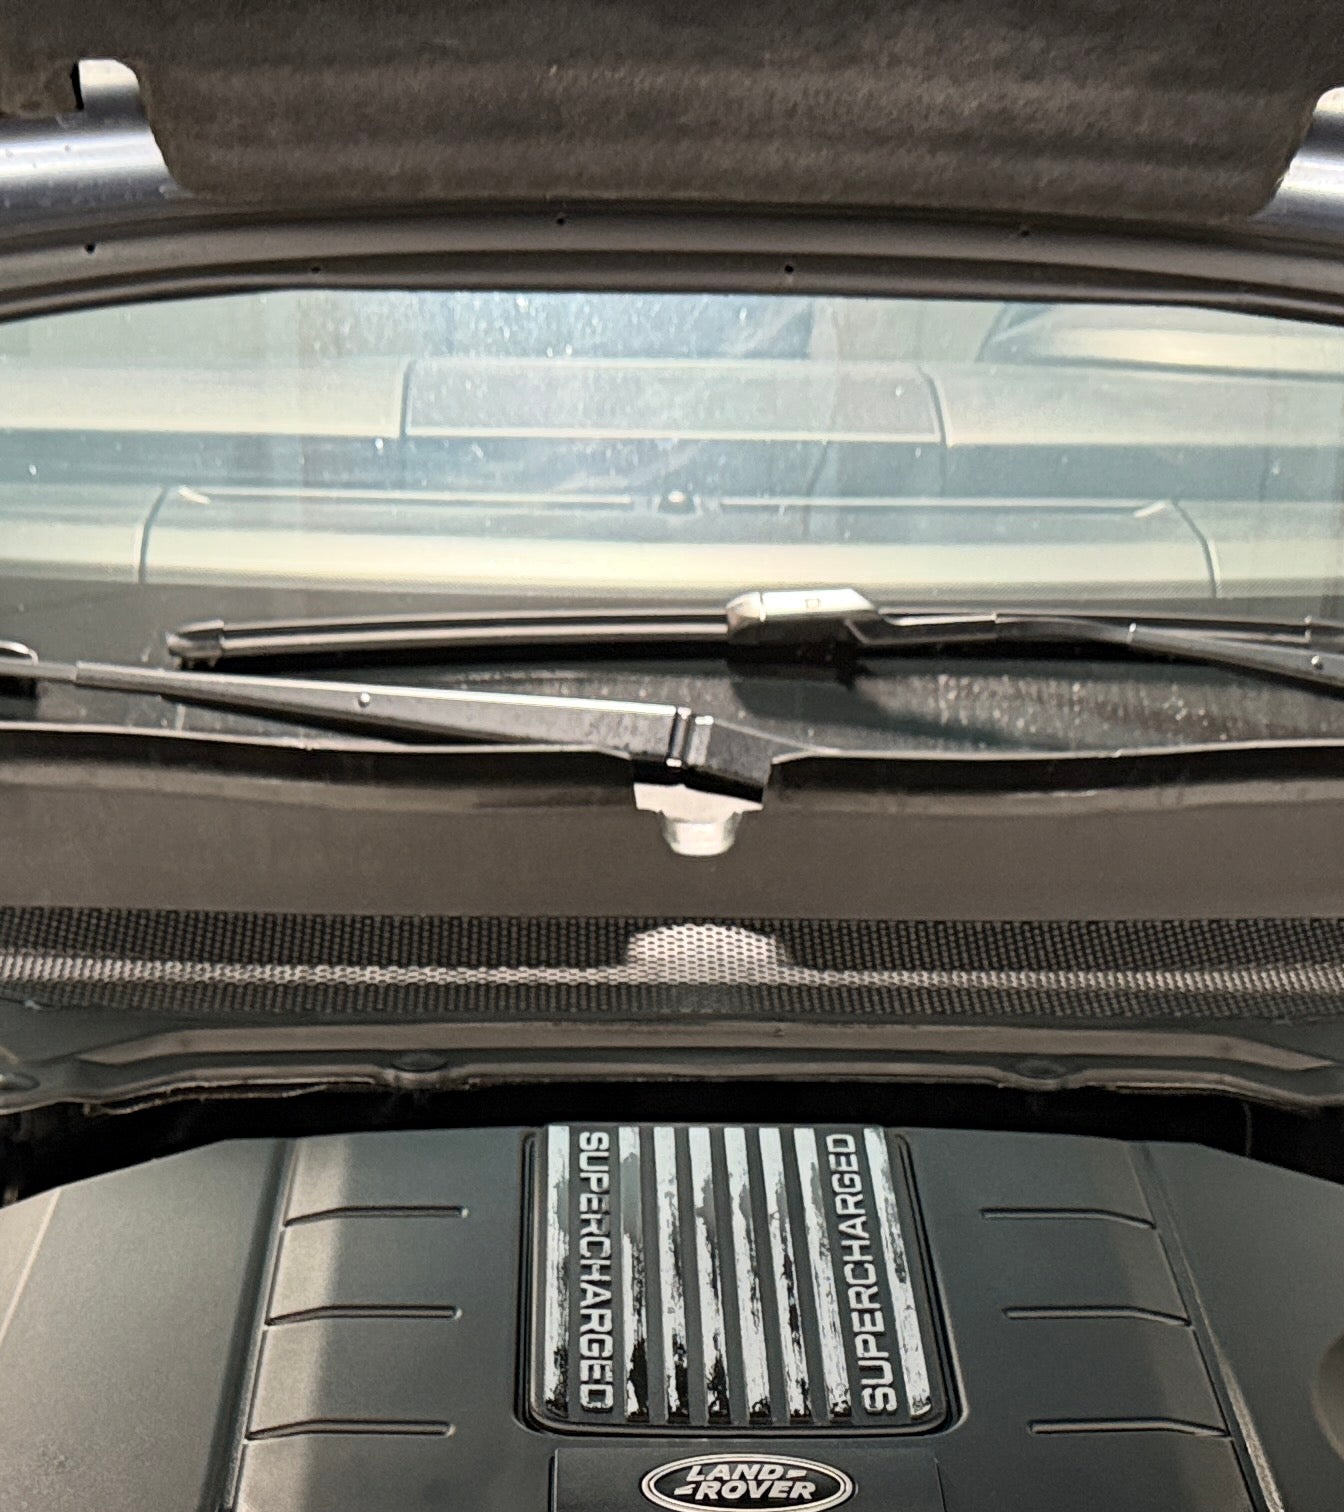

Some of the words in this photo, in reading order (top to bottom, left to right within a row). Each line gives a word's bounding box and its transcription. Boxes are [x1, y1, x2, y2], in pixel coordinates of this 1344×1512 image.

[578, 1130, 614, 1413] SUPERCHARGED
[825, 1132, 899, 1414] SUPERCHARGED
[686, 1463, 784, 1482] LAND
[694, 1480, 817, 1501] ROVER
